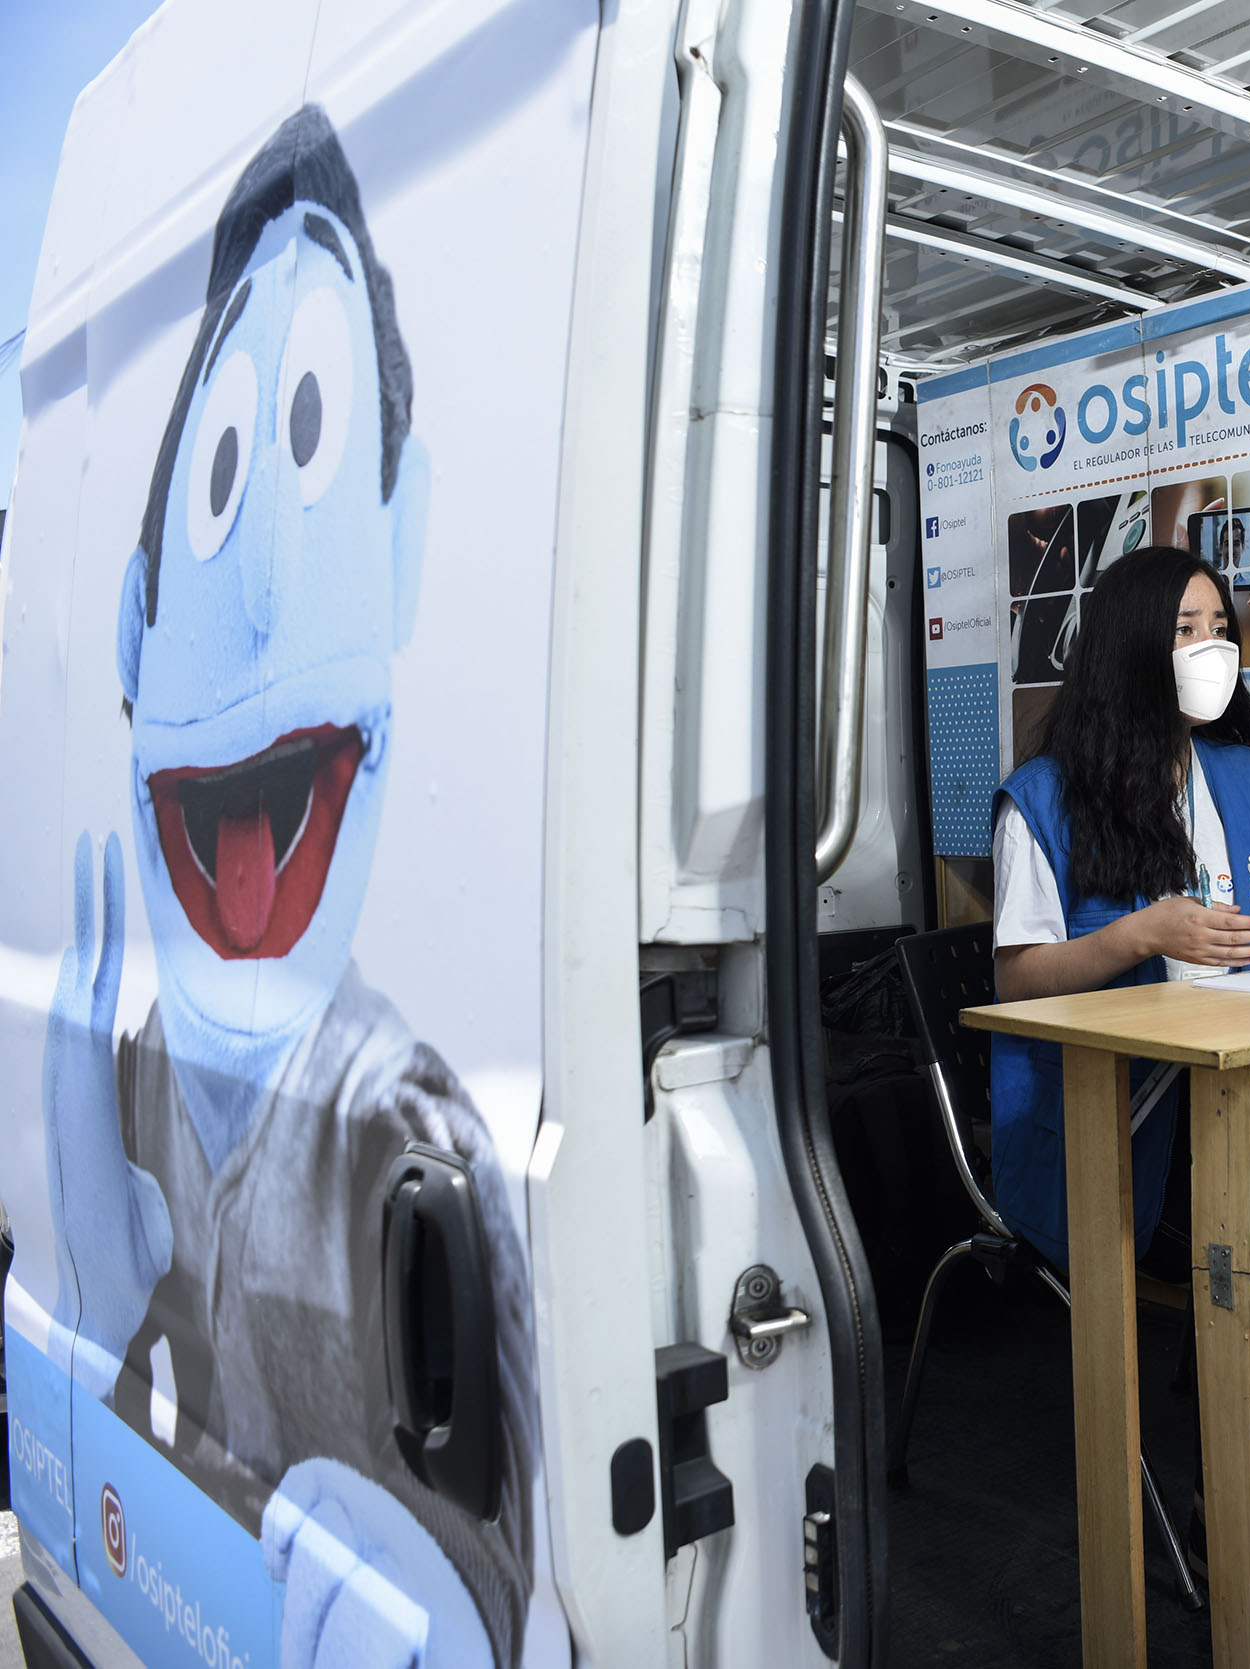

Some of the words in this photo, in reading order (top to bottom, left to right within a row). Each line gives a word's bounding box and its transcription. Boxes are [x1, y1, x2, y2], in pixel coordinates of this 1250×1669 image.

[920, 421, 988, 448] Contáctanos:
[936, 454, 982, 475] Fonoayuda
[1073, 460, 1082, 470] EL
[1086, 448, 1141, 468] REGULADOR
[1143, 444, 1154, 457] DE
[1158, 440, 1174, 453] LAS
[927, 468, 984, 492] 0-801-12121
[941, 568, 976, 583] @OSIPTEL
[944, 616, 992, 632] /OsiptelOficial
